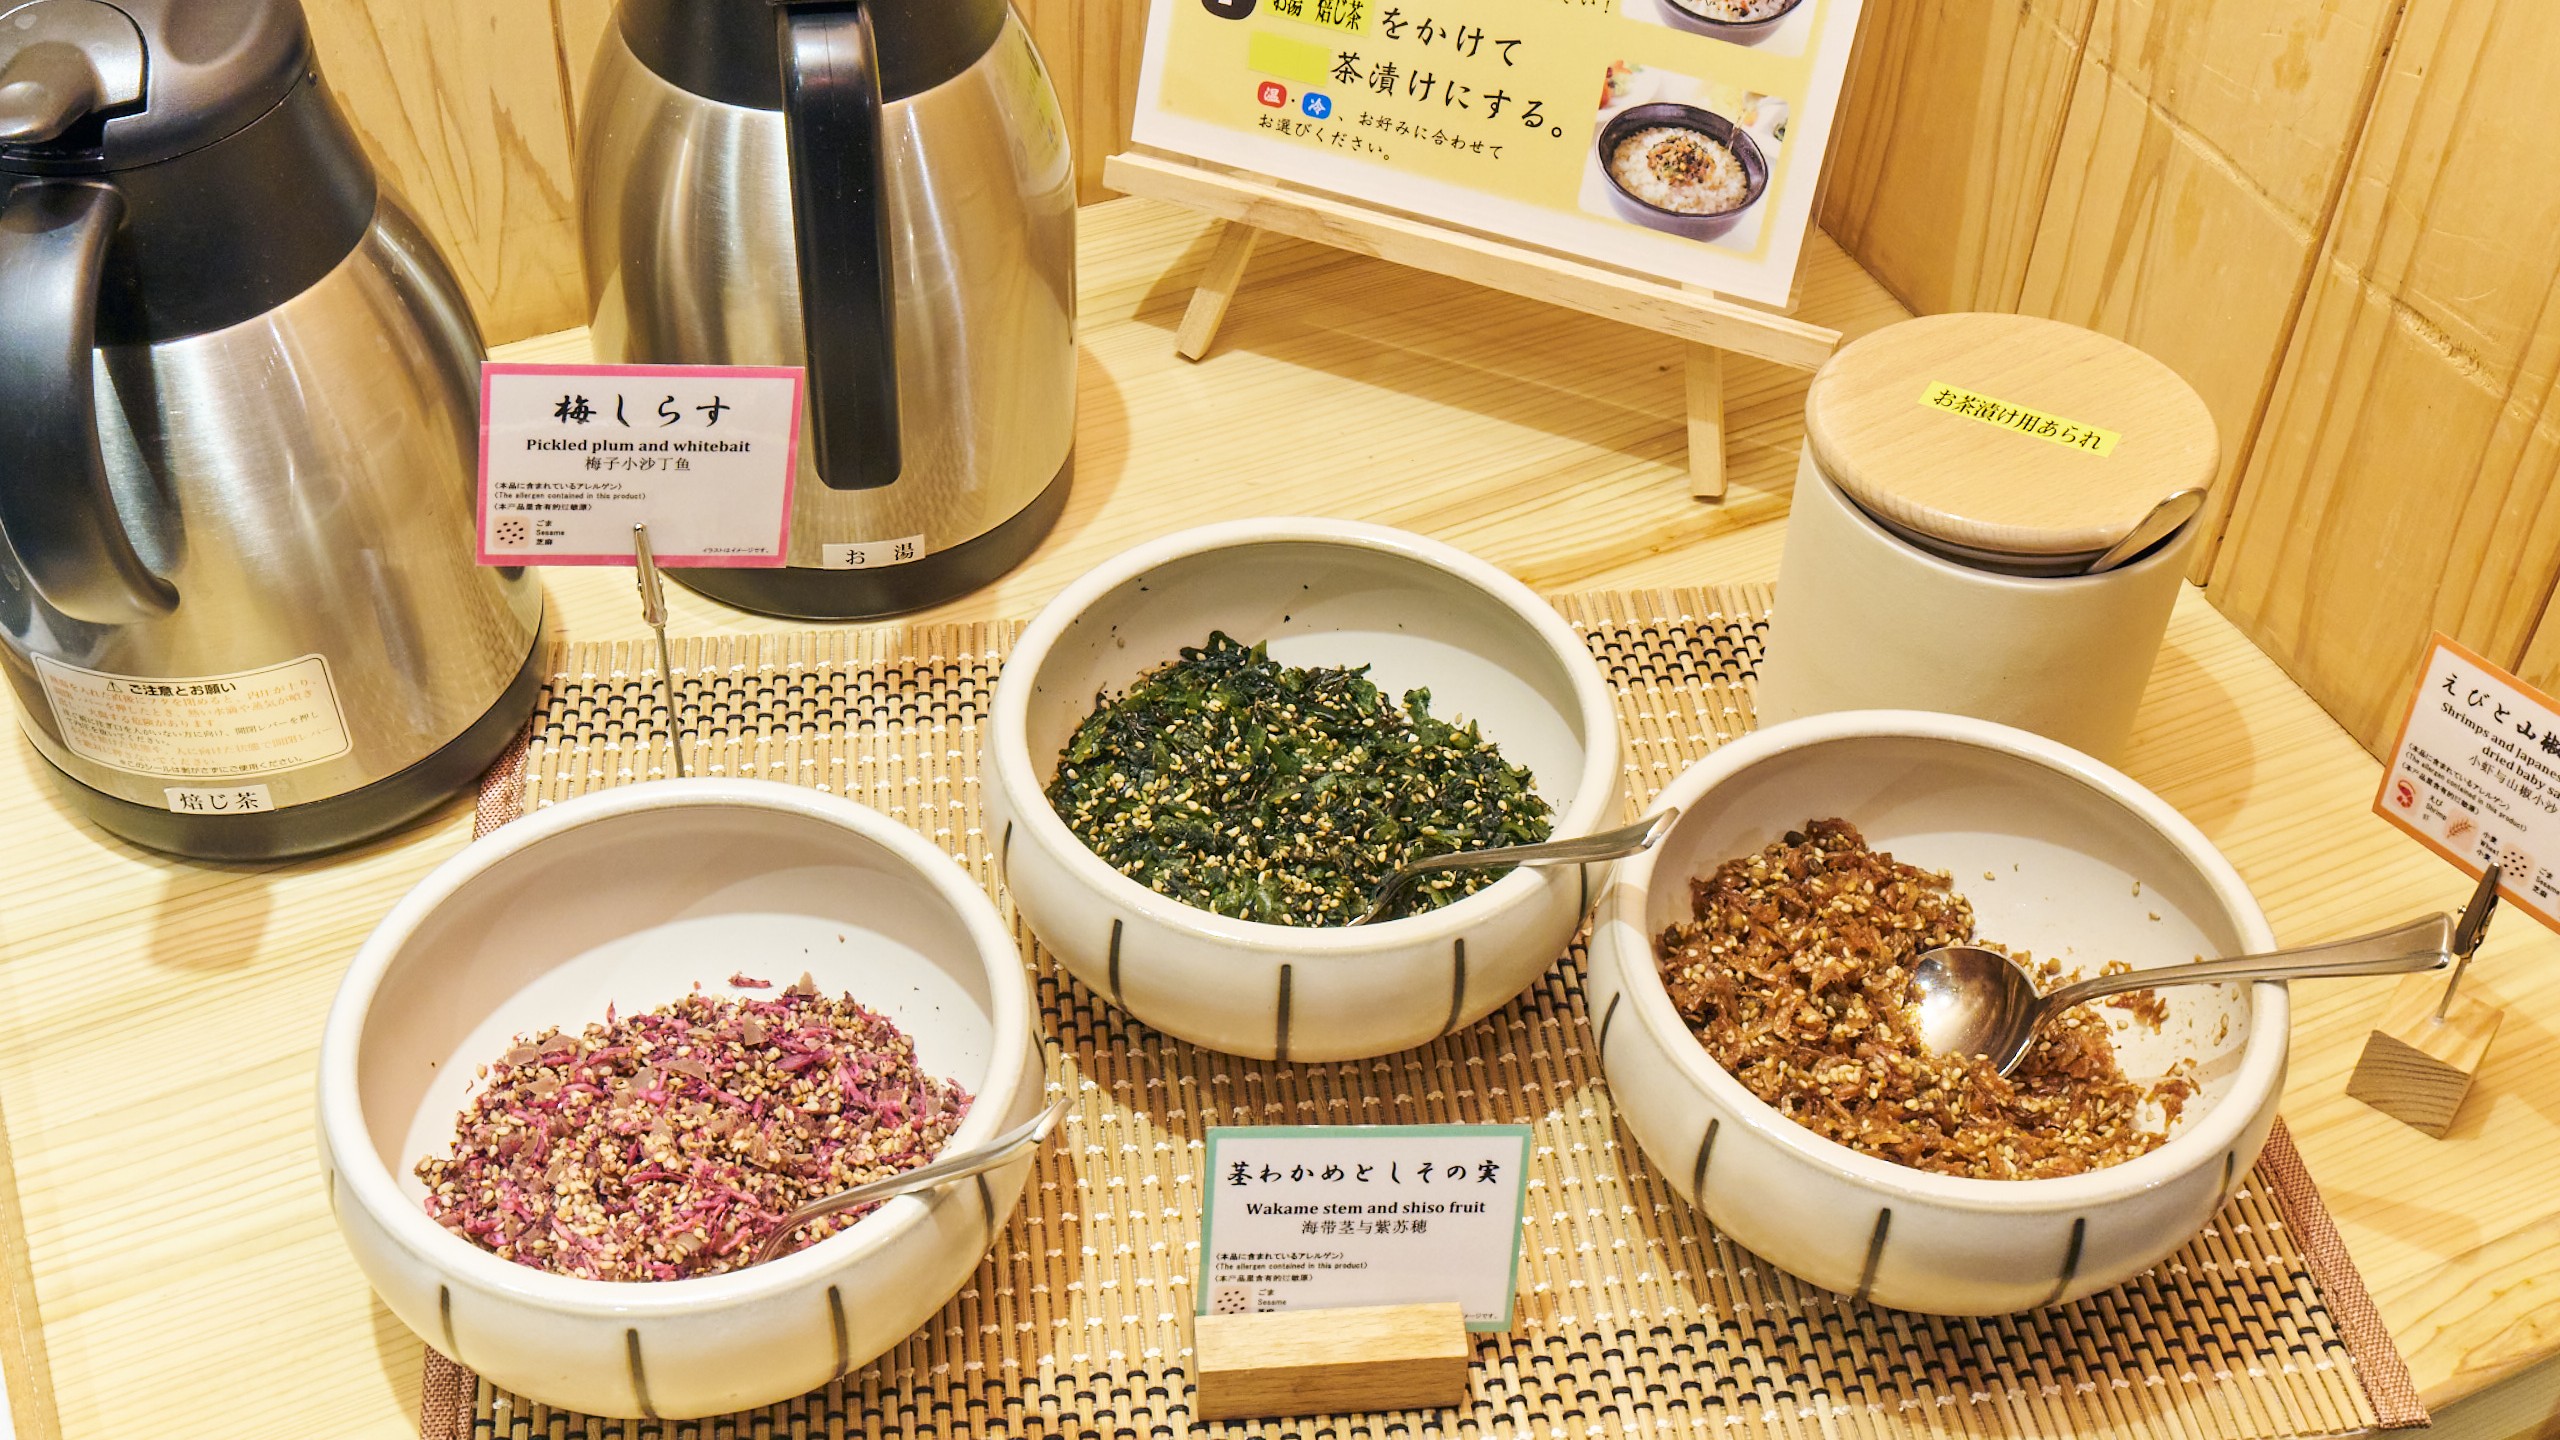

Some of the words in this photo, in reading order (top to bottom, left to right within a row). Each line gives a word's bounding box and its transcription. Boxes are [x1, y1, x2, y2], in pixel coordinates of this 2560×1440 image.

[1315, 0, 1364, 30] 焙じ茶
[1382, 7, 1522, 67] をかけて
[1331, 51, 1562, 138] 茶漬けにする。
[1258, 113, 1390, 161] お選びください。
[554, 393, 731, 428] 梅しらす
[1933, 389, 2101, 450] お茶漬け用あられ
[526, 438, 588, 452] Pickled
[592, 439, 634, 454] plum
[638, 439, 670, 452] and
[673, 439, 751, 453] whitebait
[585, 456, 691, 471] 梅子小沙丁鱼
[515, 492, 545, 501] allergen
[547, 492, 584, 500] contained
[586, 492, 594, 500] in
[596, 492, 611, 500] this
[536, 519, 553, 527] ごま
[846, 542, 914, 565] お湯
[128, 680, 237, 697] ご注意とお願い
[2441, 702, 2490, 738] Shrimps
[2491, 733, 2515, 752] and
[2482, 746, 2515, 771] dried
[2516, 766, 2546, 790] baby
[180, 792, 259, 811] 焙じ茶
[2446, 778, 2477, 801] contained
[2485, 802, 2498, 814] this
[2425, 802, 2447, 821] Shrimp
[2480, 839, 2500, 856] Wheat
[1227, 1159, 1500, 1186] 茎わかめとしその実
[1246, 1202, 1318, 1215] Wakame
[1323, 1203, 1363, 1214] stem
[1367, 1202, 1398, 1214] and
[1402, 1202, 1445, 1214] shiso
[1449, 1201, 1486, 1215] fruit
[1236, 1263, 1266, 1271] allergen
[1318, 1262, 1332, 1270] this
